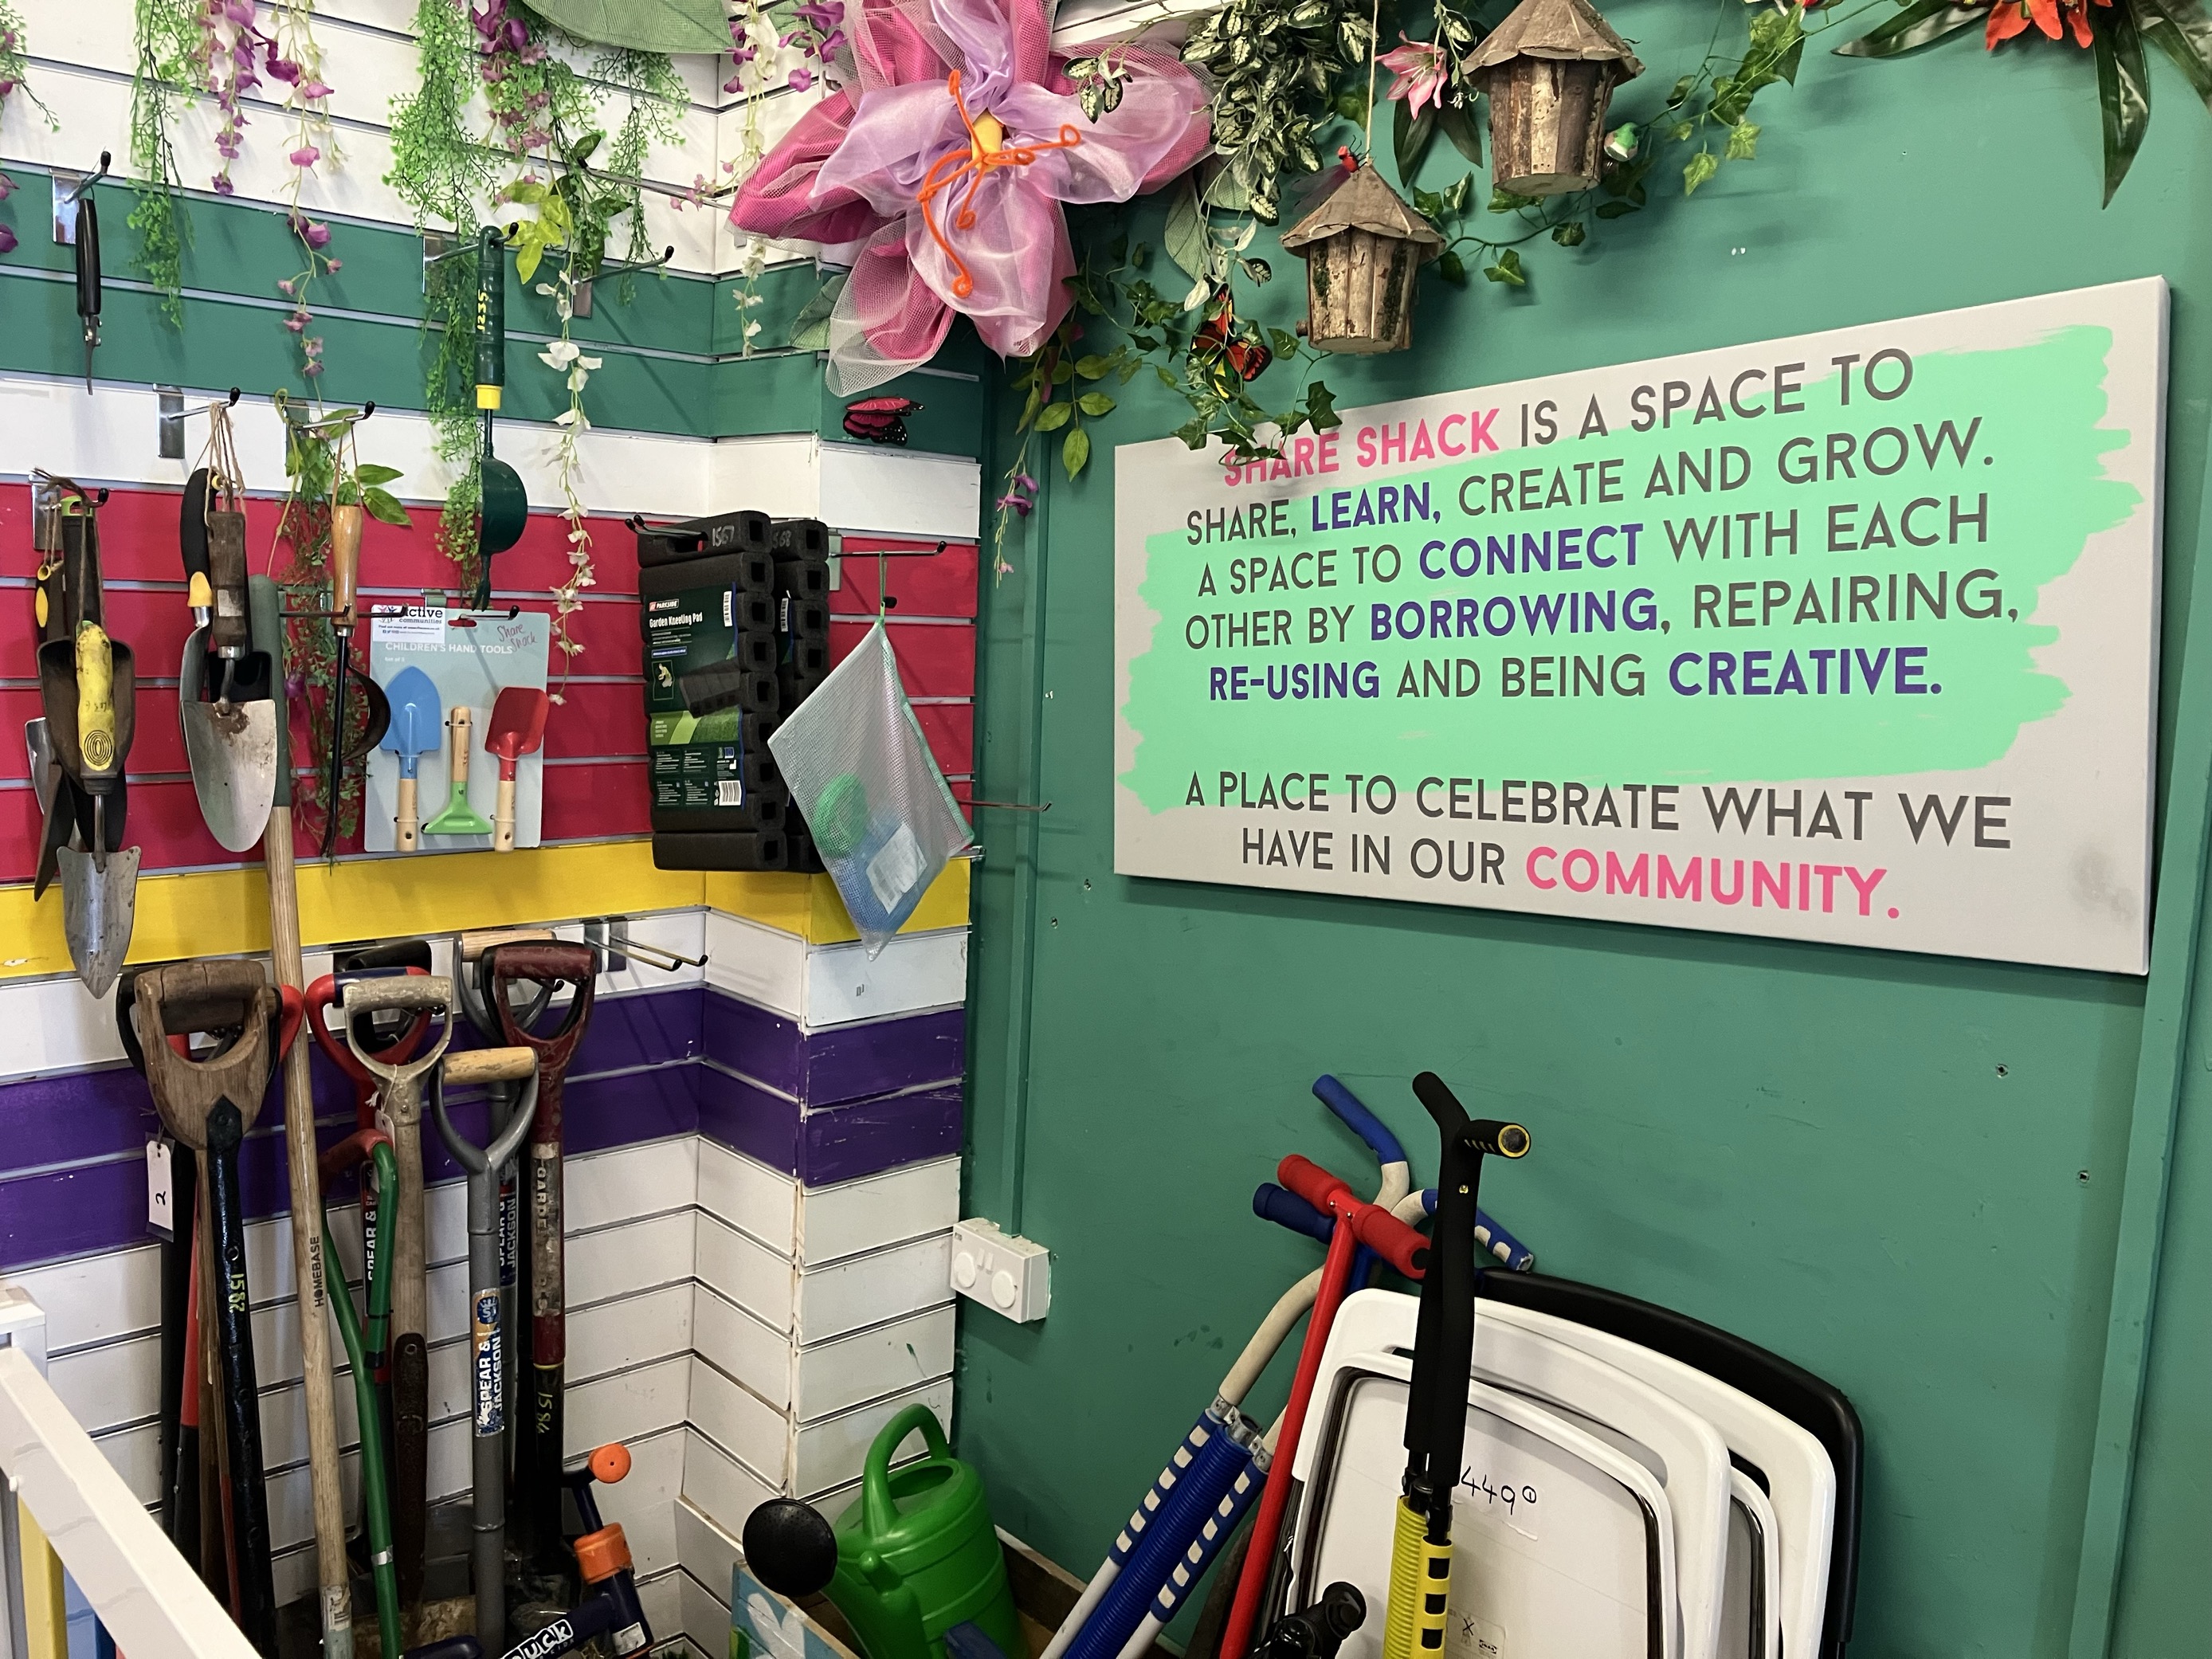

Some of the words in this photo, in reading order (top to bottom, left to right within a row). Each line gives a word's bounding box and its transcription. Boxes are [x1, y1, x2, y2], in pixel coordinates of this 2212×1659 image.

[477, 289, 489, 331] 1235
[1356, 408, 1500, 468] SHACK
[1520, 400, 1558, 447] IS
[1579, 394, 1609, 441] A
[1630, 362, 1806, 433] SPACE
[1832, 348, 1913, 406] TO
[1186, 500, 1297, 546] SHARE,
[1312, 482, 1441, 532] LEARN,
[1458, 459, 1624, 516] CREATE
[1644, 445, 1751, 499] AND
[1778, 417, 1994, 484] GROW.
[1198, 563, 1218, 597] A
[1230, 550, 1338, 594] SPACE
[1352, 544, 1402, 585] TO
[1420, 524, 1644, 579] CONNECT
[1664, 509, 1798, 563] WITH
[1827, 492, 1989, 552] EACH
[405, 606, 443, 618] ctive
[497, 622, 526, 643] Share
[649, 616, 668, 629] Garden
[668, 614, 692, 626] Kneeling
[692, 611, 703, 623] Pad
[1186, 610, 1292, 649] OTHER
[1309, 604, 1355, 645] BY
[1371, 587, 1671, 641] BORROWING,
[1694, 569, 2019, 629] REPAIRING,
[385, 642, 446, 653] CHILDREN'S
[449, 644, 477, 653] HAND
[480, 645, 513, 655] TOOLS
[1210, 661, 1379, 701] RE-USING
[1397, 659, 1481, 698] AND
[1502, 653, 1645, 698] BEING
[1669, 646, 1943, 696] CREATIVE.
[1186, 771, 1206, 806] A
[1219, 771, 1330, 813] PLACE
[1346, 774, 1397, 816] TO
[1416, 777, 1680, 830] CELEBRATE
[1701, 786, 1873, 841] WHAT
[1897, 792, 2012, 849] WE
[1242, 827, 1334, 870] HAVE
[1351, 833, 1390, 875] IN
[1410, 837, 1505, 886] OUR
[1525, 846, 1900, 920] COMMUNITY.
[155, 1190, 167, 1206] 2
[365, 1210, 377, 1222] &
[506, 1198, 516, 1269] JACKSON
[310, 1236, 324, 1308] HOMEBASE
[479, 1340, 491, 1352] &
[492, 1335, 503, 1411] JACKSON
[479, 1357, 492, 1412] SPEAR
